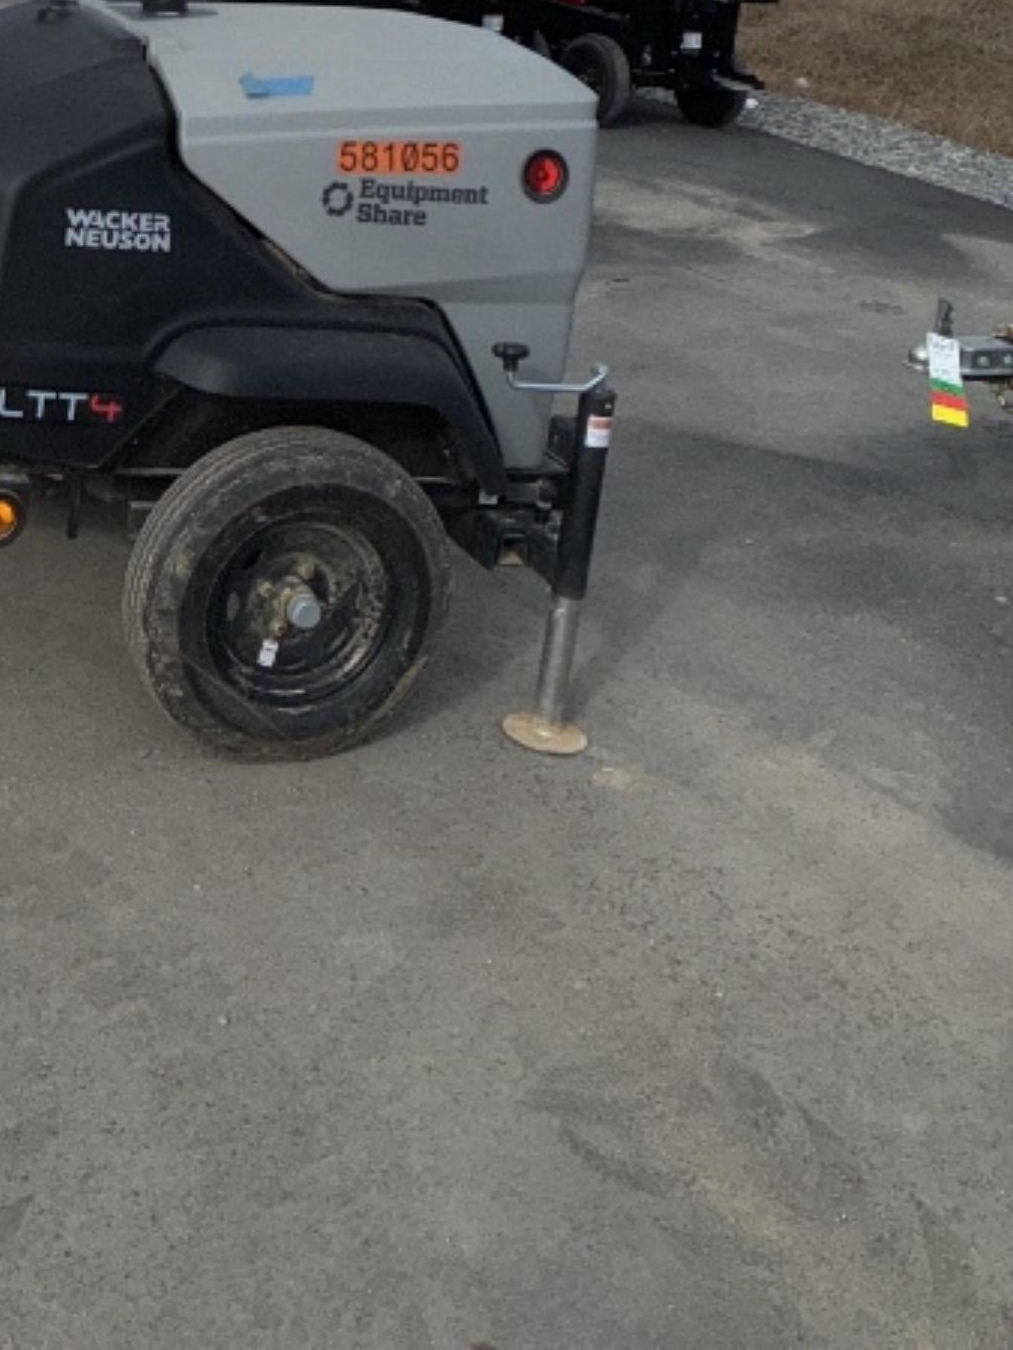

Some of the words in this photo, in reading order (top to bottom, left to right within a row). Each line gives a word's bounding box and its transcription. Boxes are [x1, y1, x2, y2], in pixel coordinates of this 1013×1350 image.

[339, 140, 459, 172] 581056
[358, 177, 489, 205] Equipment
[65, 207, 171, 233] WACKER
[356, 203, 427, 226] Share
[64, 227, 171, 253] NEUSON
